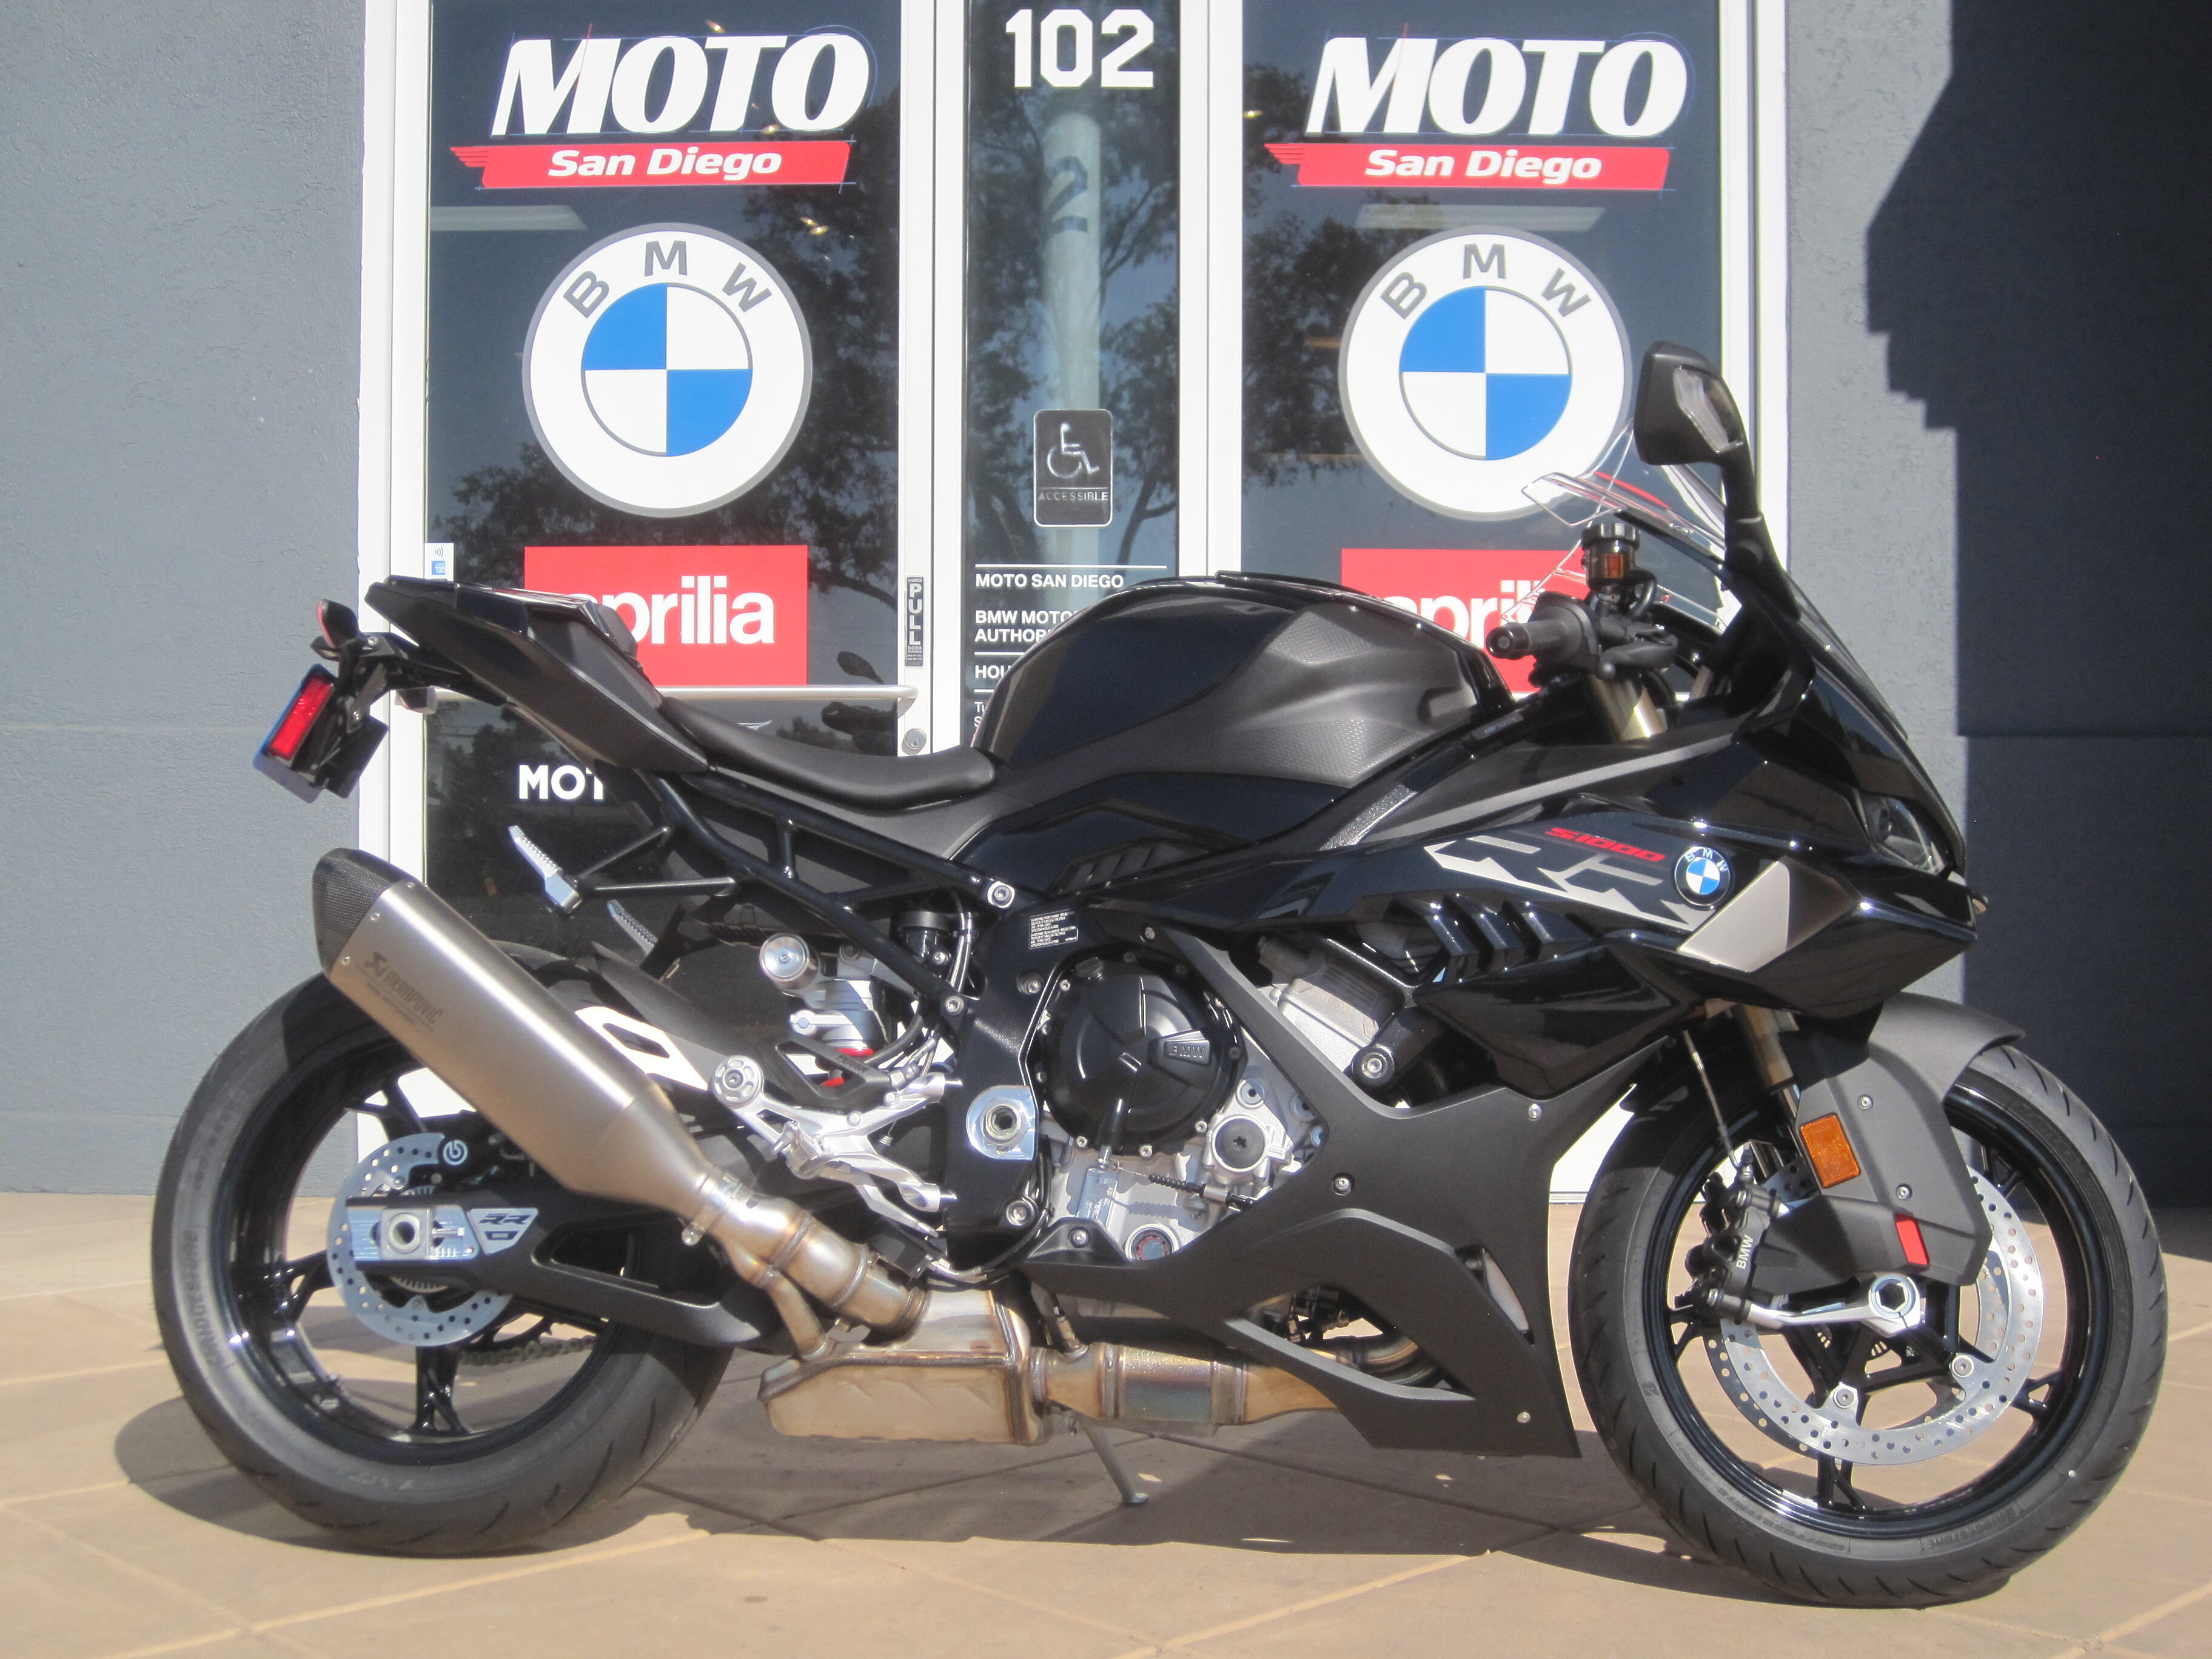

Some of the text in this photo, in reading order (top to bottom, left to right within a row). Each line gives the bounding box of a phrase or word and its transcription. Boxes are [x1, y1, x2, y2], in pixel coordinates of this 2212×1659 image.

[1005, 9, 1155, 88] 102
[491, 34, 870, 136] MOTO
[1305, 36, 1688, 137] MOTO
[547, 147, 782, 181] San Diego
[1365, 149, 1602, 185] San Diego
[563, 241, 773, 319] BMW
[1380, 244, 1592, 320] BMW
[1037, 491, 1108, 501] ACCESSIBLE
[975, 574, 1124, 589] MOTO SAN DIEGO
[574, 575, 775, 644] prilia
[908, 583, 922, 645] PULL
[975, 610, 1078, 624] BMW MOTO
[1382, 580, 1546, 648] pril
[974, 628, 1051, 643] AUTHOR
[1545, 827, 1666, 862] S1000
[1684, 847, 1729, 872] BMW
[1168, 1045, 1205, 1059] BMW
[1735, 1233, 1754, 1270] BMW
